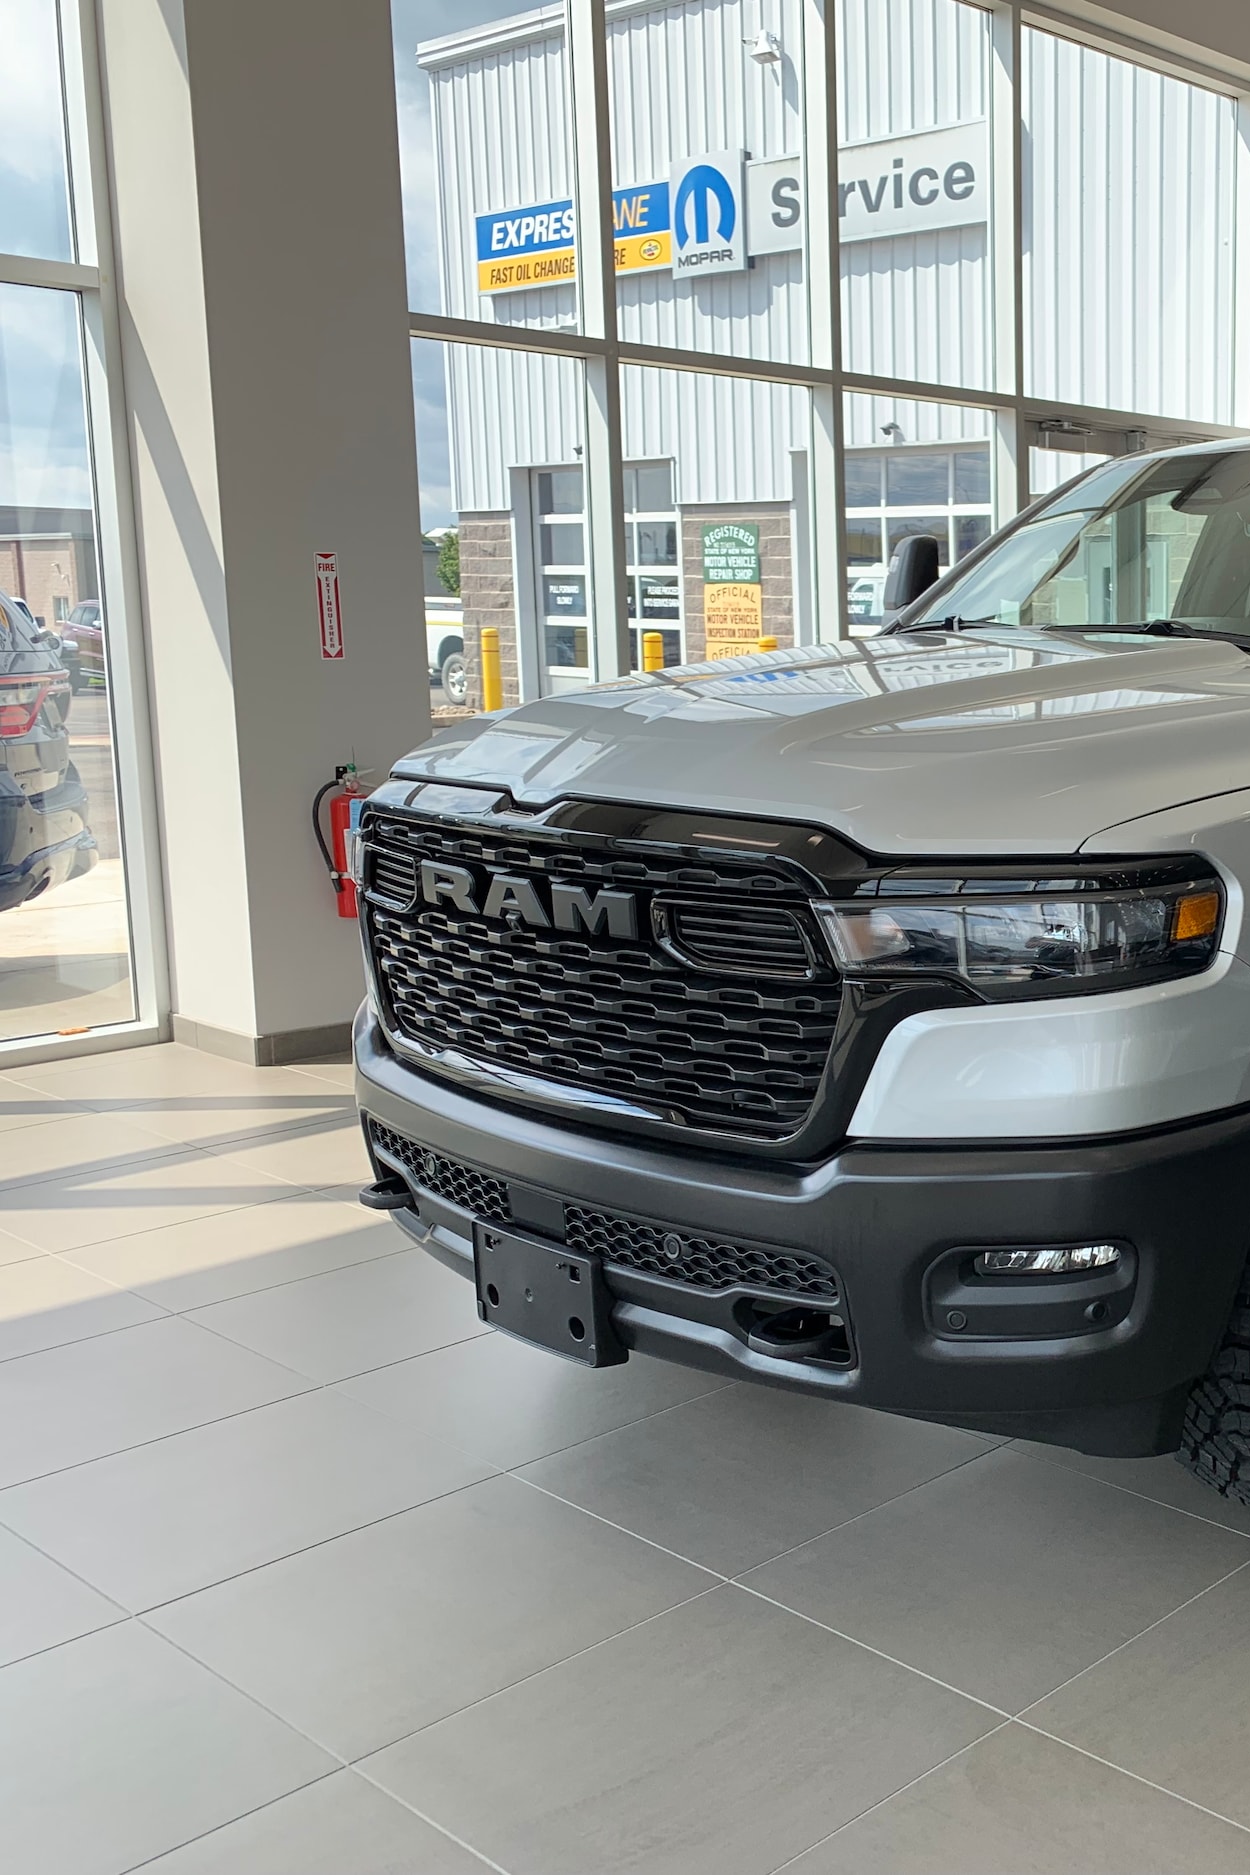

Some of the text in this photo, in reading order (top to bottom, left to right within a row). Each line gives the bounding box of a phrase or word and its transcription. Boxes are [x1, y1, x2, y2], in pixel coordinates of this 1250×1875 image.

[771, 157, 976, 228] Srvice
[490, 194, 650, 251] EXPRES ANE
[677, 249, 733, 268] MOPAR
[490, 266, 514, 285] FAST
[516, 263, 531, 281] OIL
[533, 256, 575, 279] CHANGE
[704, 525, 755, 547] REGISTERED
[318, 563, 335, 572] FIRE
[704, 556, 756, 567] MOTOR VEHICLE
[709, 569, 753, 580] REPAIR SHOP
[709, 586, 756, 604] OFFICIAL
[325, 576, 335, 648] EXTINGUISHER
[707, 614, 759, 625] MOTOR VEHICLE
[707, 627, 759, 638] INSPECTION STATION
[712, 646, 750, 660] OFFICIA
[421, 859, 639, 940] RAM
